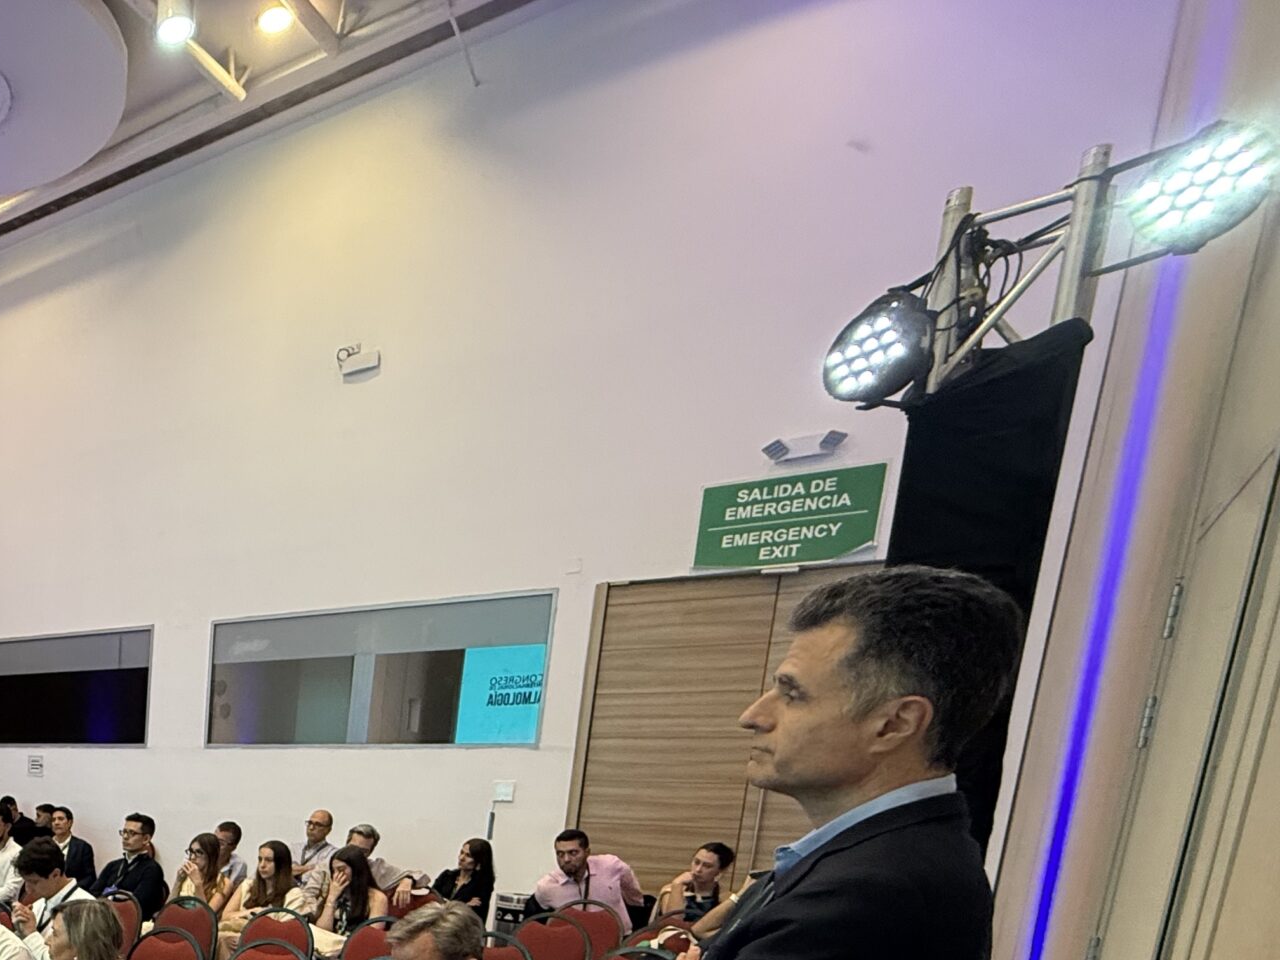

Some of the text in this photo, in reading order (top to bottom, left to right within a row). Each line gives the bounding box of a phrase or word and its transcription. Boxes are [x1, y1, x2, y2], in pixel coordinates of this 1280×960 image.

[736, 477, 838, 503] SALIDA DE
[725, 493, 851, 521] EMERGENCIA
[721, 522, 842, 548] EMERGENCY
[758, 543, 801, 560] EXIT
